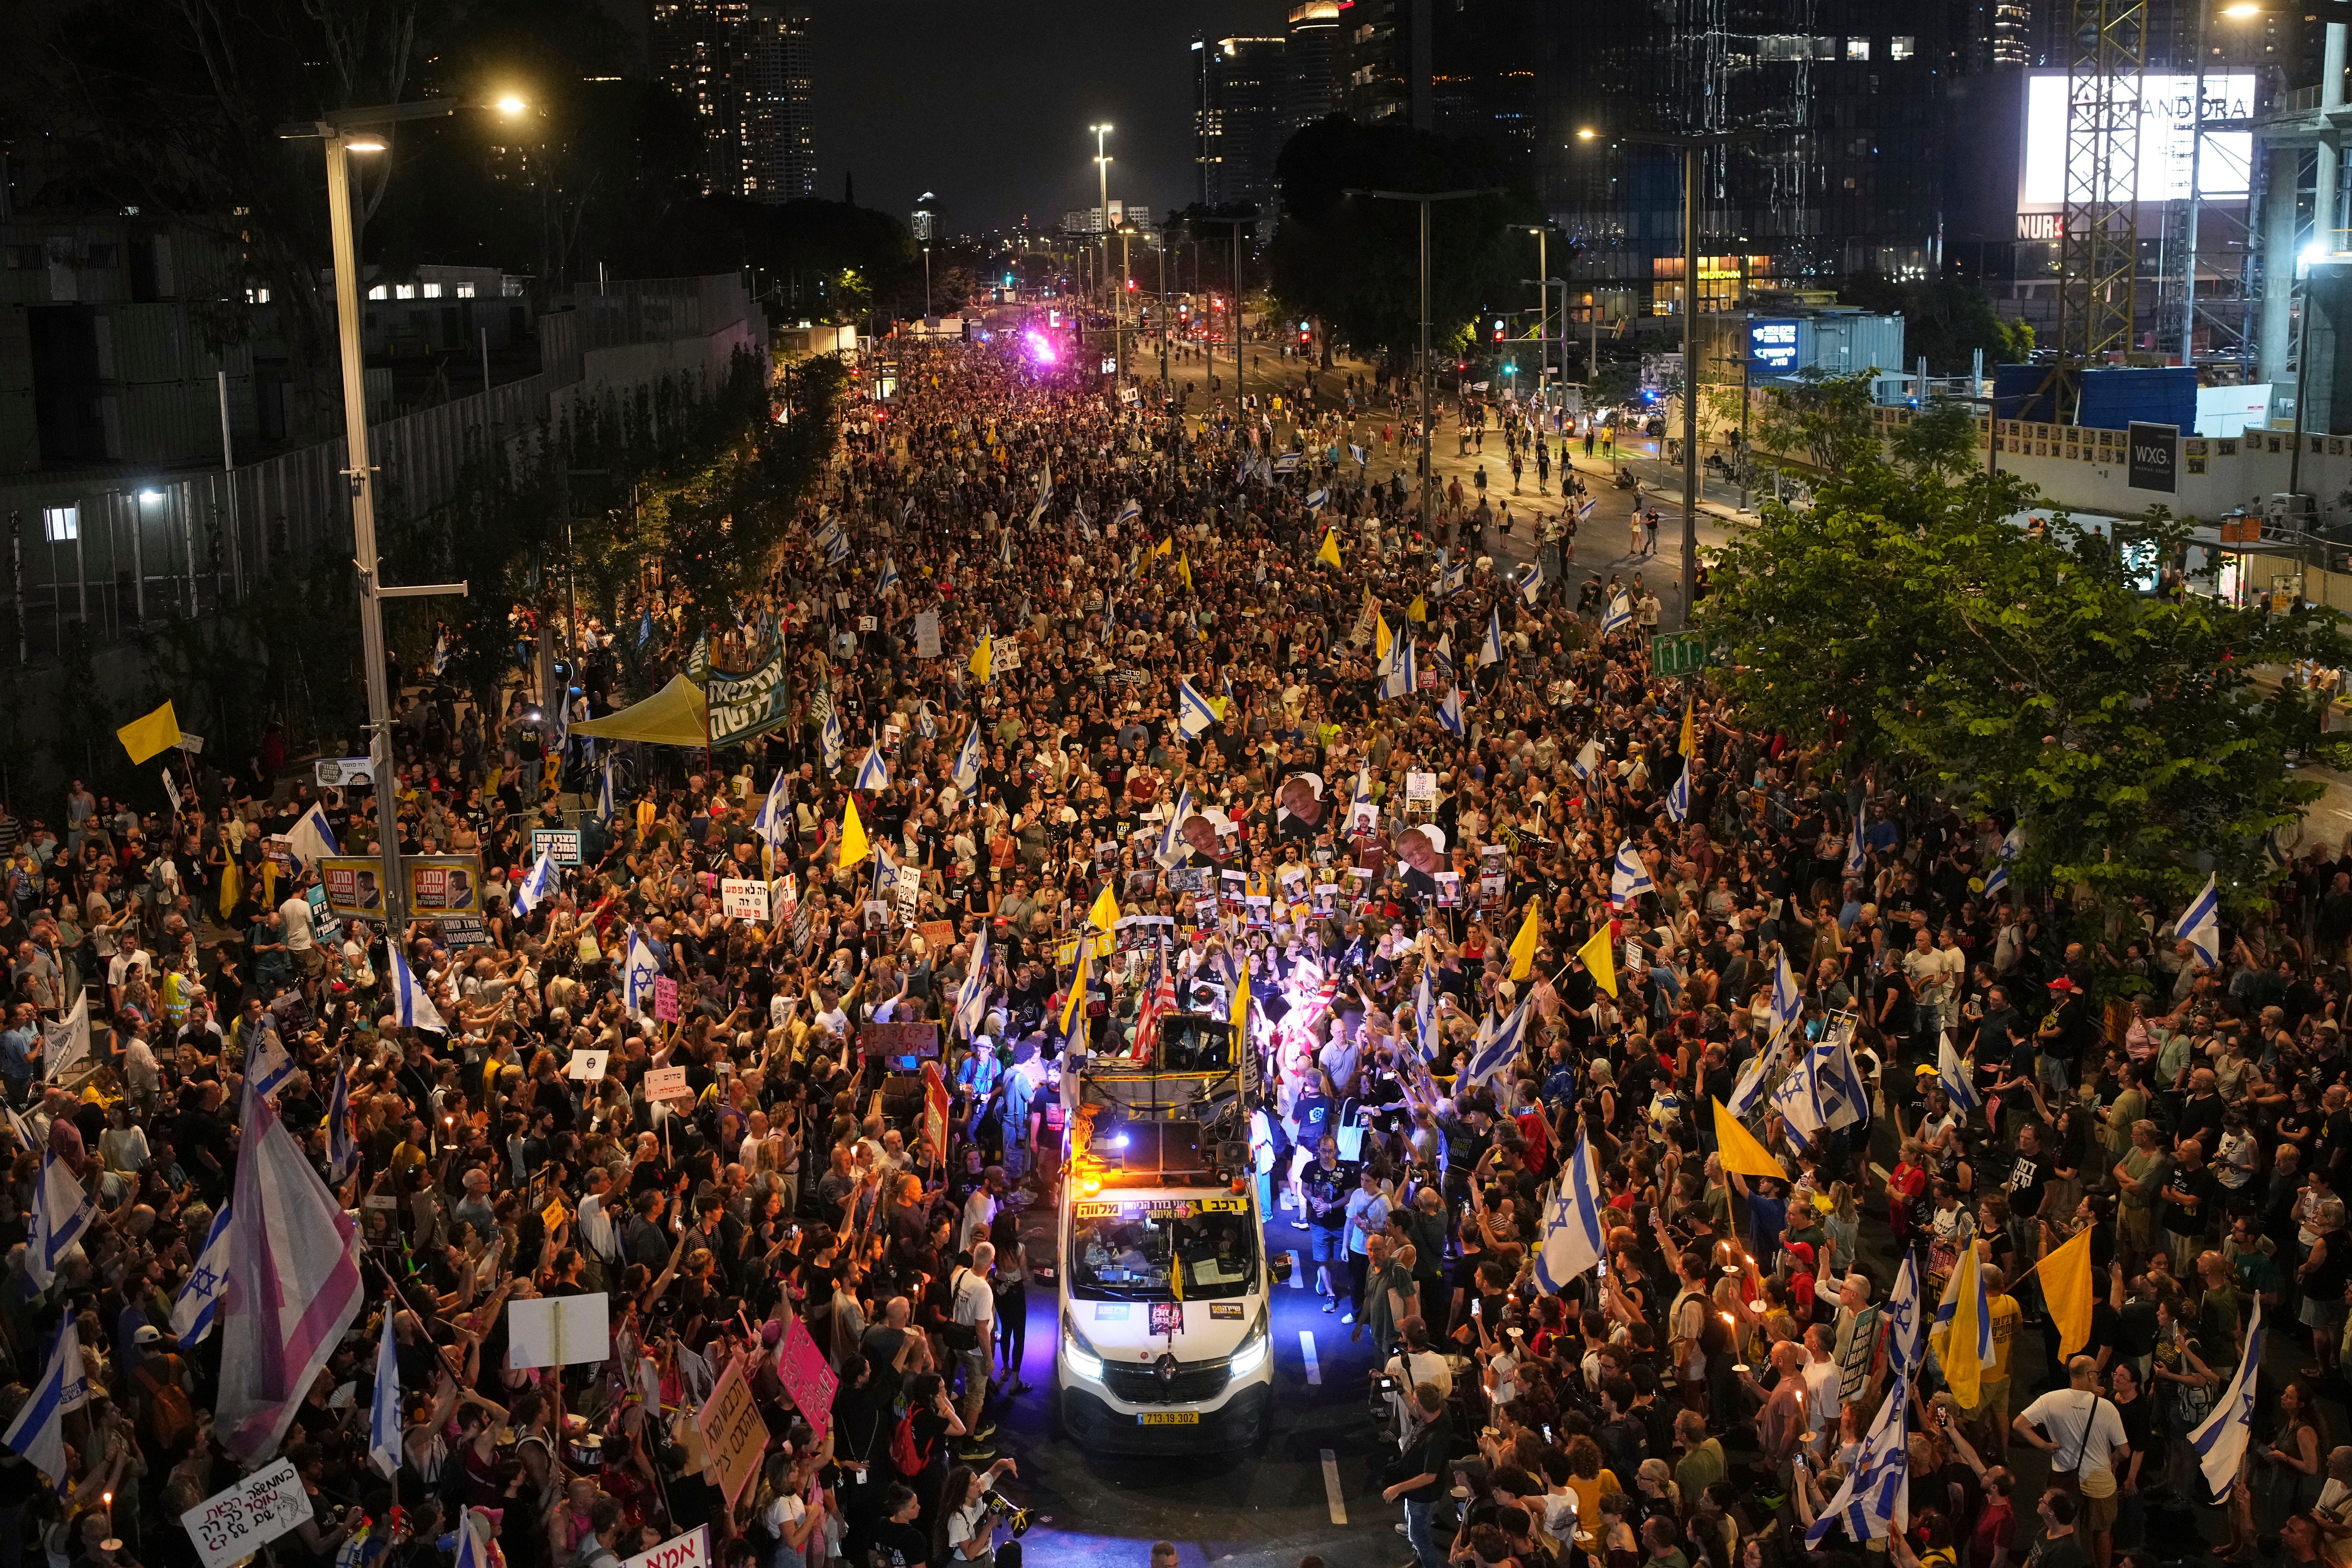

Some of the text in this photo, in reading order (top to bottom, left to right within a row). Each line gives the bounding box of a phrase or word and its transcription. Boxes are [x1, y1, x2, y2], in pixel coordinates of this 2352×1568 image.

[2129, 99, 2247, 120] ANDORA
[1698, 270, 1741, 279] MIDTOWN
[710, 692, 772, 740] לנשק
[554, 834, 576, 842] עצרו
[537, 843, 577, 852] המלחה
[333, 871, 352, 884] מתן
[423, 869, 443, 883] מתן
[904, 870, 918, 884] רוצים
[417, 884, 444, 894] אנגרסט
[746, 883, 755, 894] לא
[757, 886, 767, 895] זה
[900, 885, 915, 899] אותם
[739, 898, 750, 906] זה
[444, 920, 480, 929] END THE
[447, 932, 485, 944] BLOODSHED
[1104, 940, 1110, 952] 3
[659, 1085, 686, 1094] ממשלה
[1080, 1203, 1119, 1215] מלווה
[1212, 1200, 1238, 1210] רכב
[1145, 1209, 1173, 1218] איתם?
[1848, 1344, 1870, 1361] BLOOD
[246, 1469, 294, 1500] בממשלה
[245, 1490, 278, 1512] מוסר
[253, 1508, 274, 1526] שם
[228, 1522, 249, 1539] של
